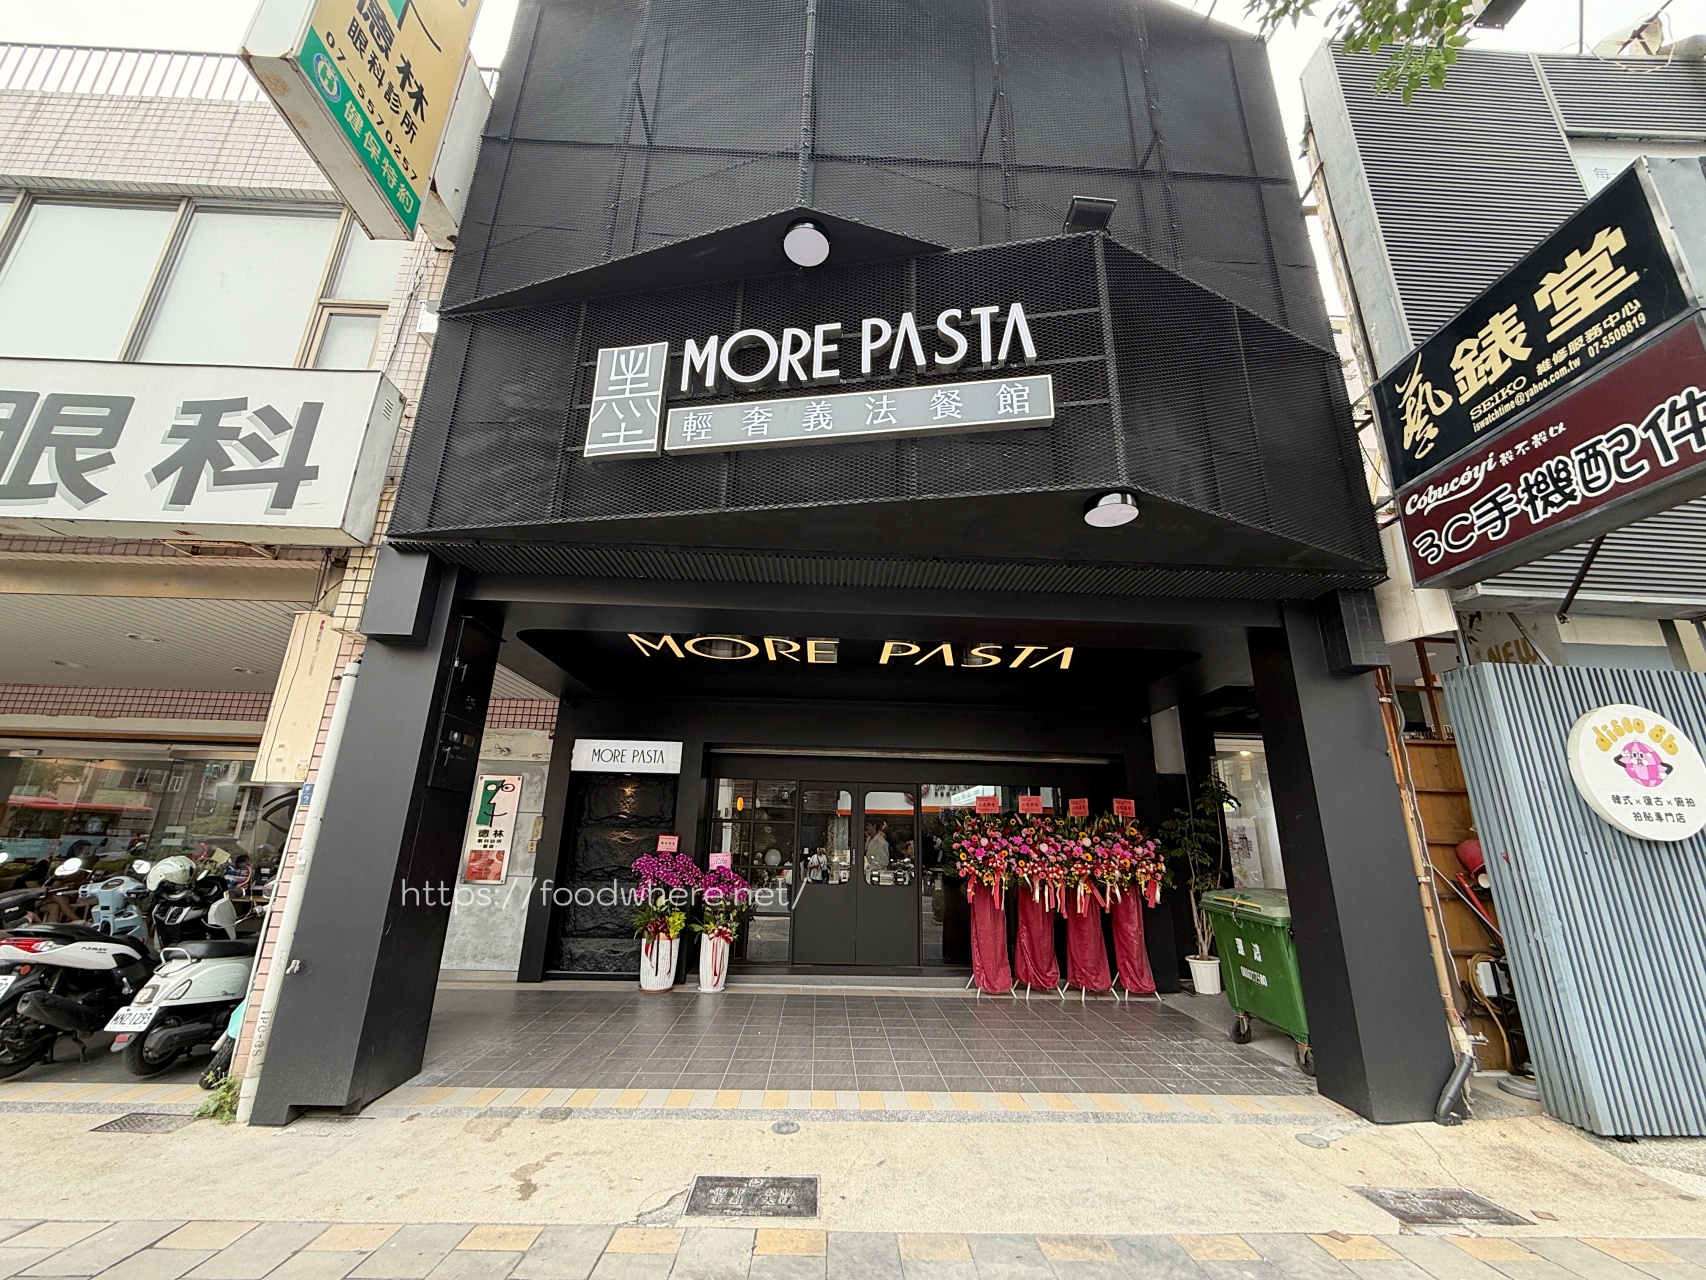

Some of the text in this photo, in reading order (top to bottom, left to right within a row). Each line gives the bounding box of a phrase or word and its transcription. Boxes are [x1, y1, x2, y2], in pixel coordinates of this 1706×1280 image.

[347, 16, 418, 144] 眼科診所
[343, 100, 415, 214] 健保特約
[681, 302, 1037, 393] MORE PASTA
[1469, 298, 1642, 420] SEIKO 維修服務中心
[1472, 311, 1647, 433] iswatchtime@yahoo.com.tw 07-5508819
[0, 390, 324, 515] 眼科
[681, 382, 1032, 442] 輕奢義法餐館
[1413, 386, 1706, 565] 3C手機配件
[627, 633, 1075, 670] MORE PASTA
[591, 748, 665, 764] MORE PASTA
[1592, 717, 1646, 752] disco
